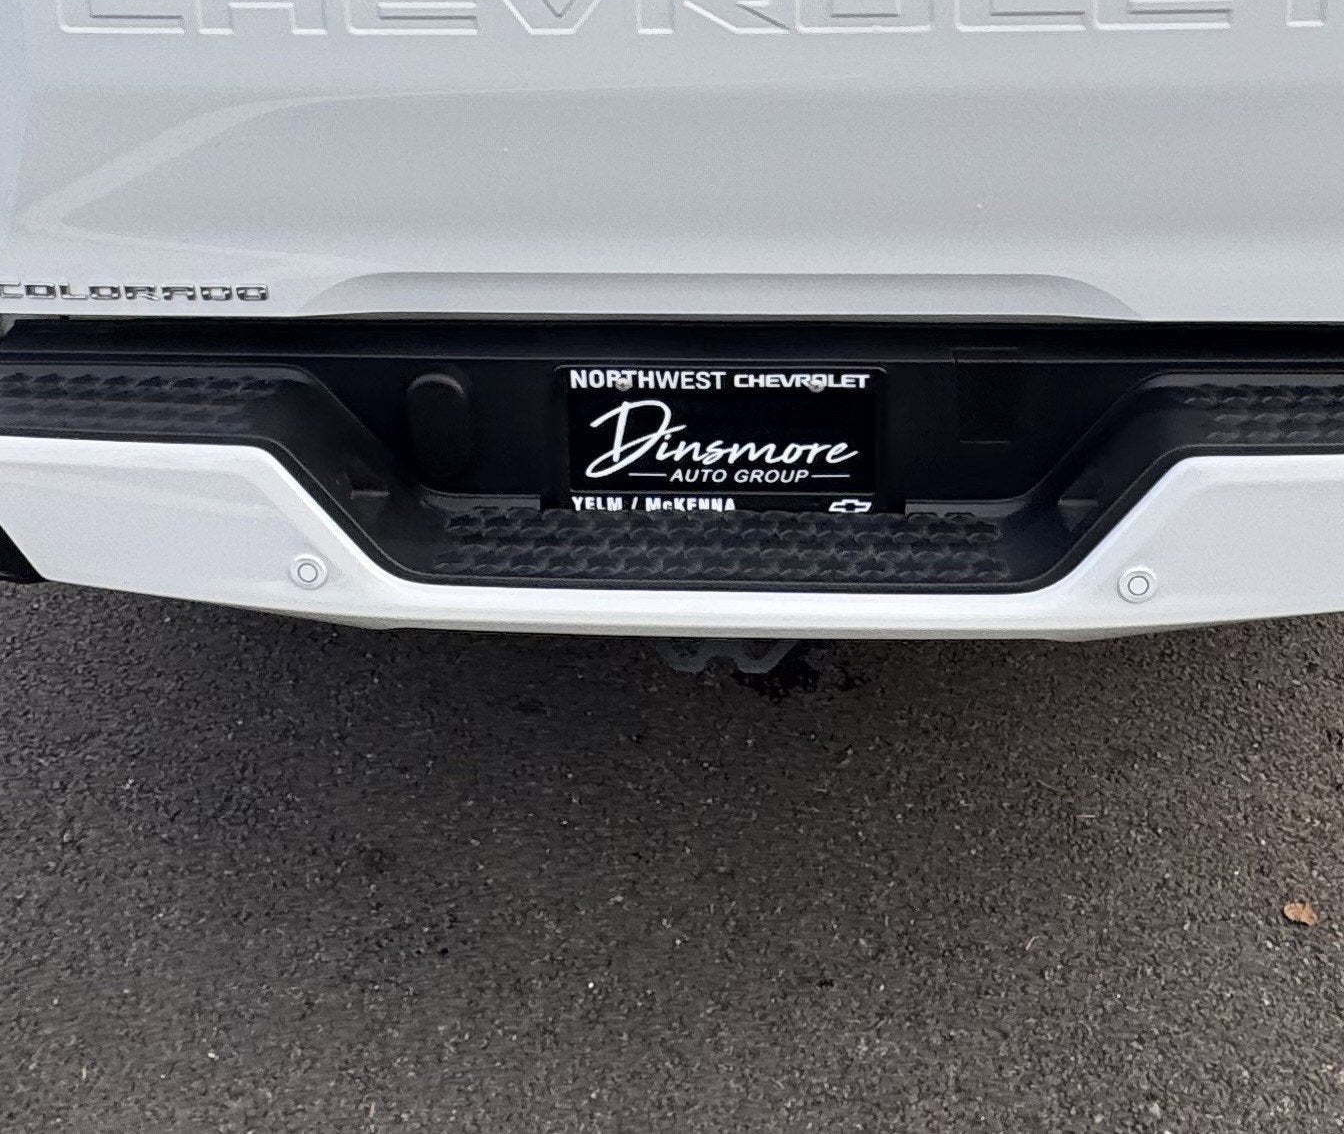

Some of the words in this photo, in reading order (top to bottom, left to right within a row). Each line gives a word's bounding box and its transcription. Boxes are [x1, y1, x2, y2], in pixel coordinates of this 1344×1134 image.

[570, 369, 726, 390] NORTHWEST
[734, 374, 871, 389] CHEVROLET
[585, 400, 858, 478] Dinsmore
[669, 469, 727, 483] AUTO
[734, 469, 809, 483] GROUP
[571, 496, 623, 512] YELM
[645, 497, 736, 513] McKENNA
